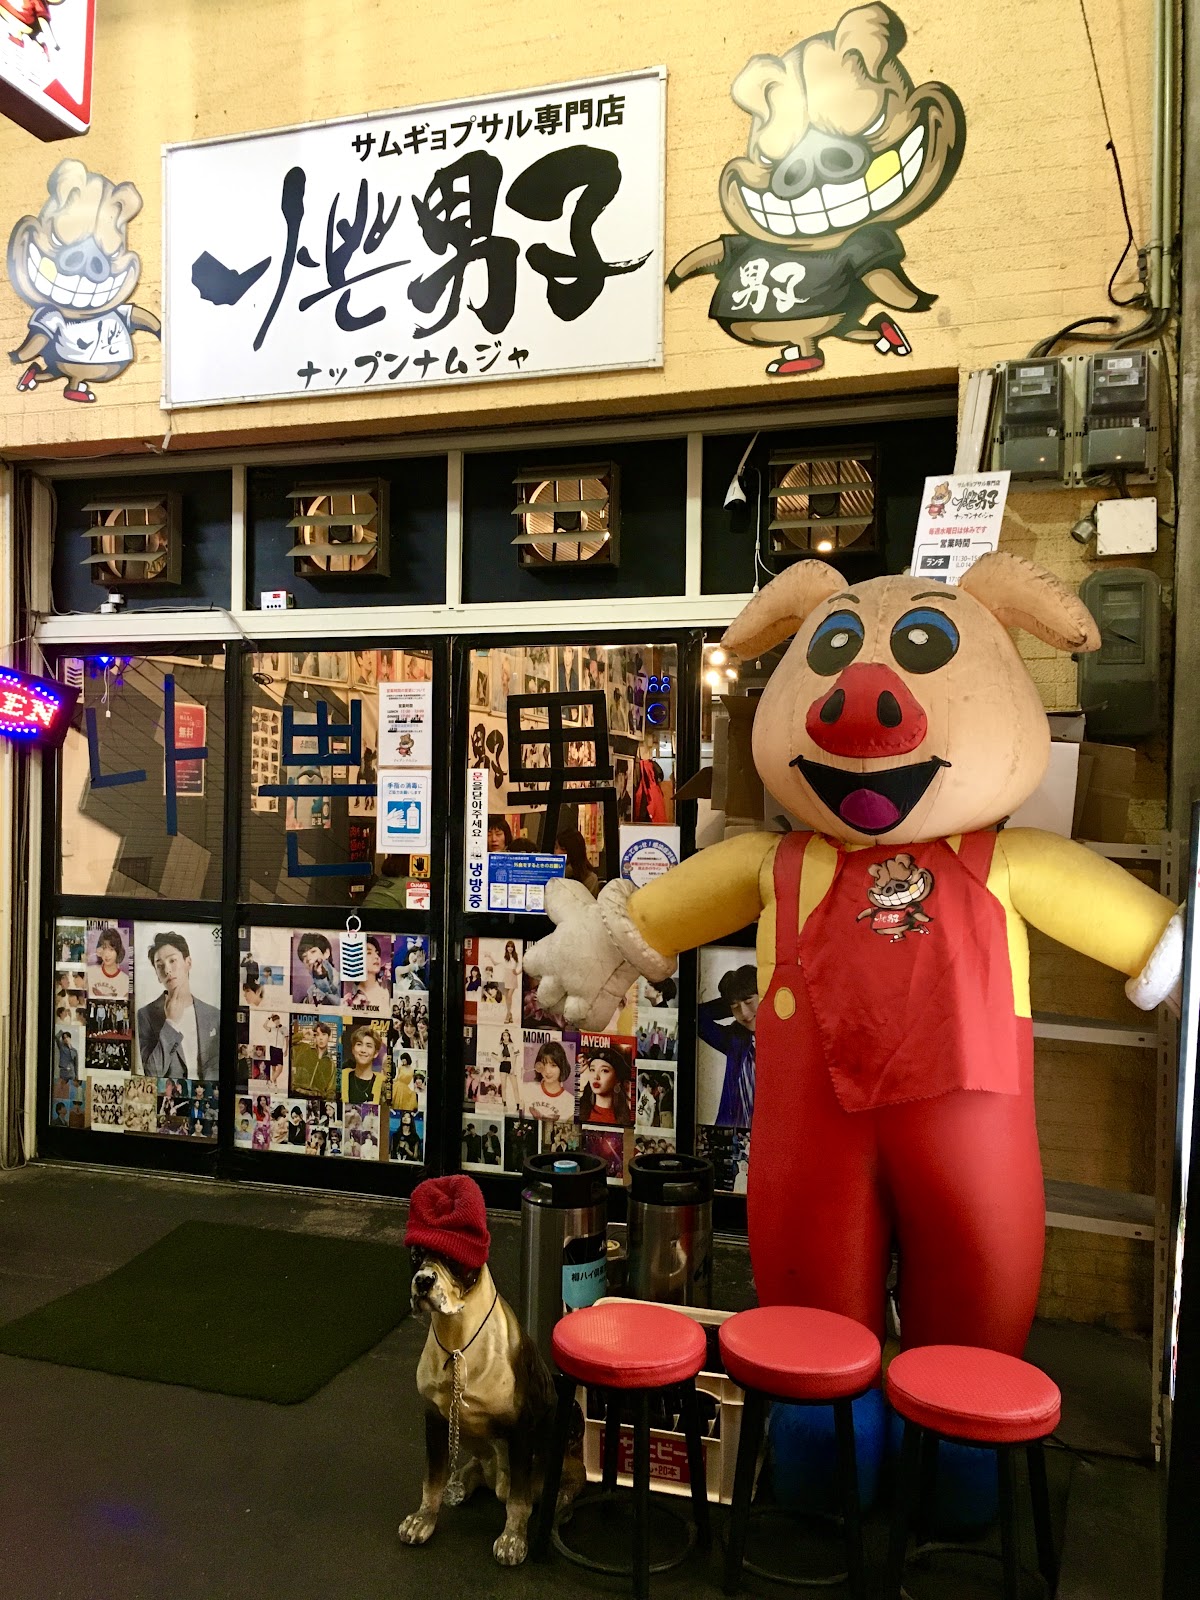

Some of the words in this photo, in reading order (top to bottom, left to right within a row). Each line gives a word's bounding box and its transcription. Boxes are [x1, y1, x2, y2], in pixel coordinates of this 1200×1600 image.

[351, 95, 625, 162] サムギョプサル専門店
[297, 343, 530, 389] ナップンナムジャ
[928, 526, 988, 536] 毎週水曜日は休みです
[940, 538, 971, 549] 営業時間
[926, 558, 944, 567] ランチ
[469, 862, 483, 909] 냉방중
[370, 1020, 390, 1031] RM
[523, 1031, 551, 1044] MOMO
